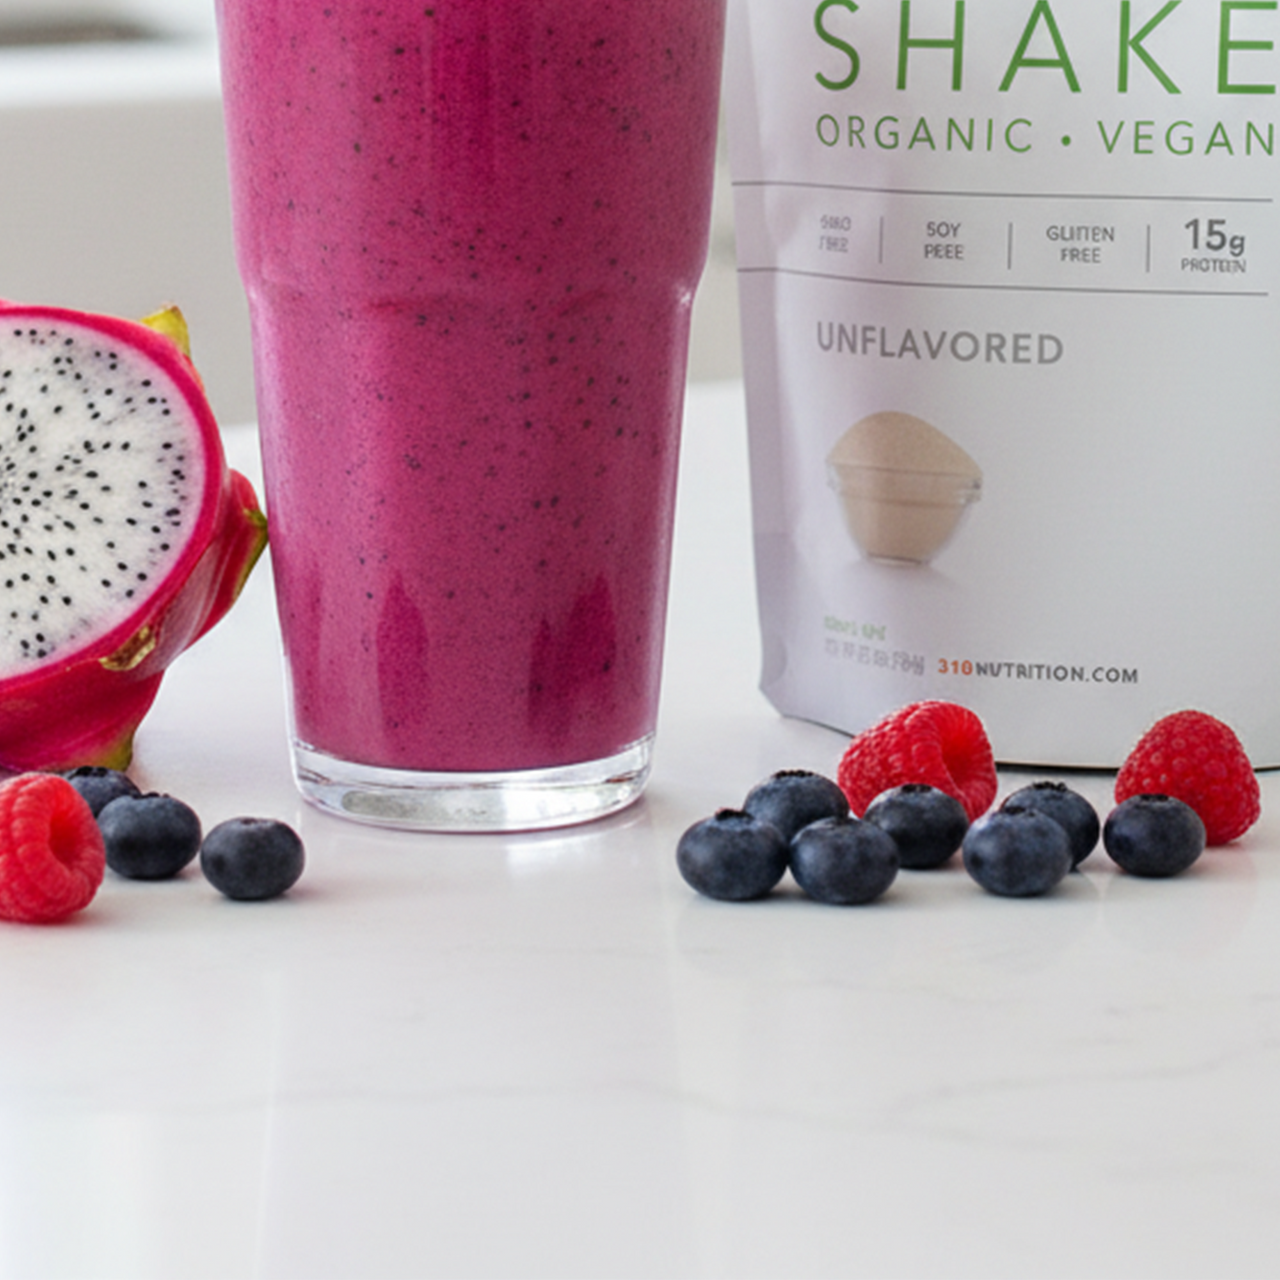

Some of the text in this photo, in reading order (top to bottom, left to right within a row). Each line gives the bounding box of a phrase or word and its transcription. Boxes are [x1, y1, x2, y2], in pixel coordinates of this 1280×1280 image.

[816, 114, 1274, 156] ORGANIC VEGAN
[926, 221, 961, 238] SOY
[1184, 218, 1245, 257] 15g
[1060, 247, 1101, 263] FREE
[817, 321, 1063, 364] UNFLAVORED
